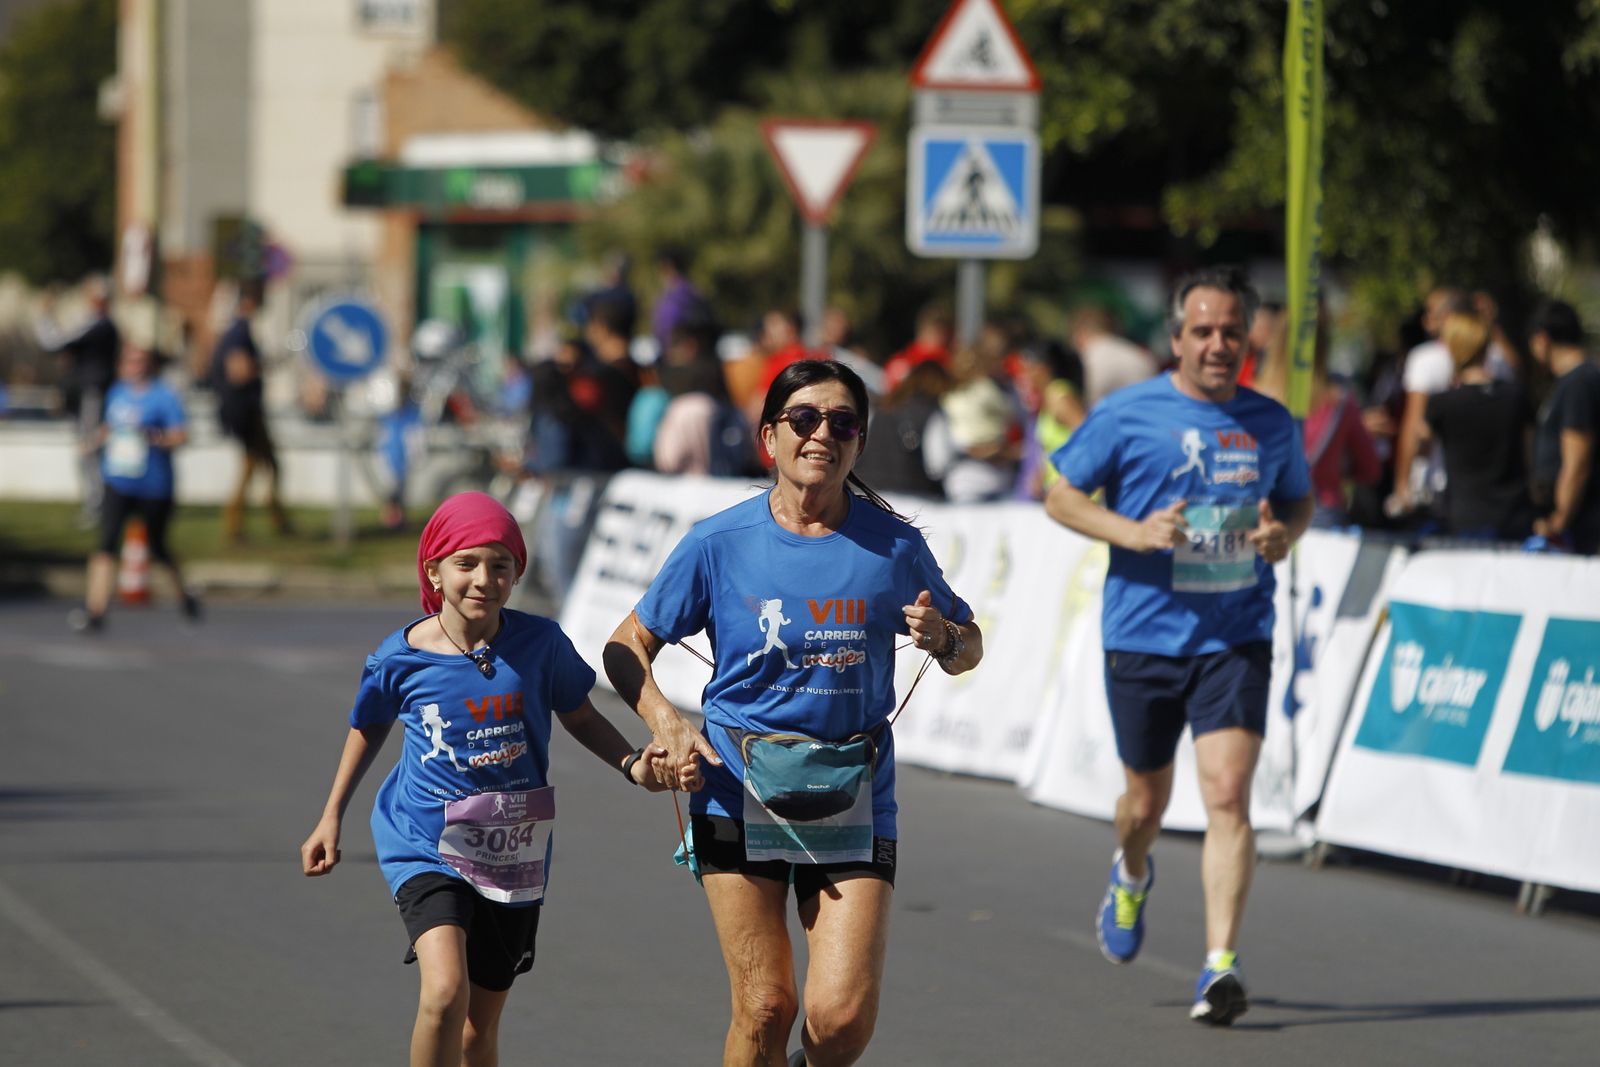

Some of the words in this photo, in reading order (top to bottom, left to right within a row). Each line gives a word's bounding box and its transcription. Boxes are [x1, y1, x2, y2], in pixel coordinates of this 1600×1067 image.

[1191, 531, 1246, 555] 2181
[807, 599, 865, 624] VIII
[804, 630, 867, 640] CARRERA
[802, 646, 866, 673] mujer
[464, 690, 523, 724] VIII
[466, 720, 525, 741] CARRERA
[468, 741, 528, 768] mujer
[508, 793, 527, 804] VIII
[463, 822, 537, 854] 3084
